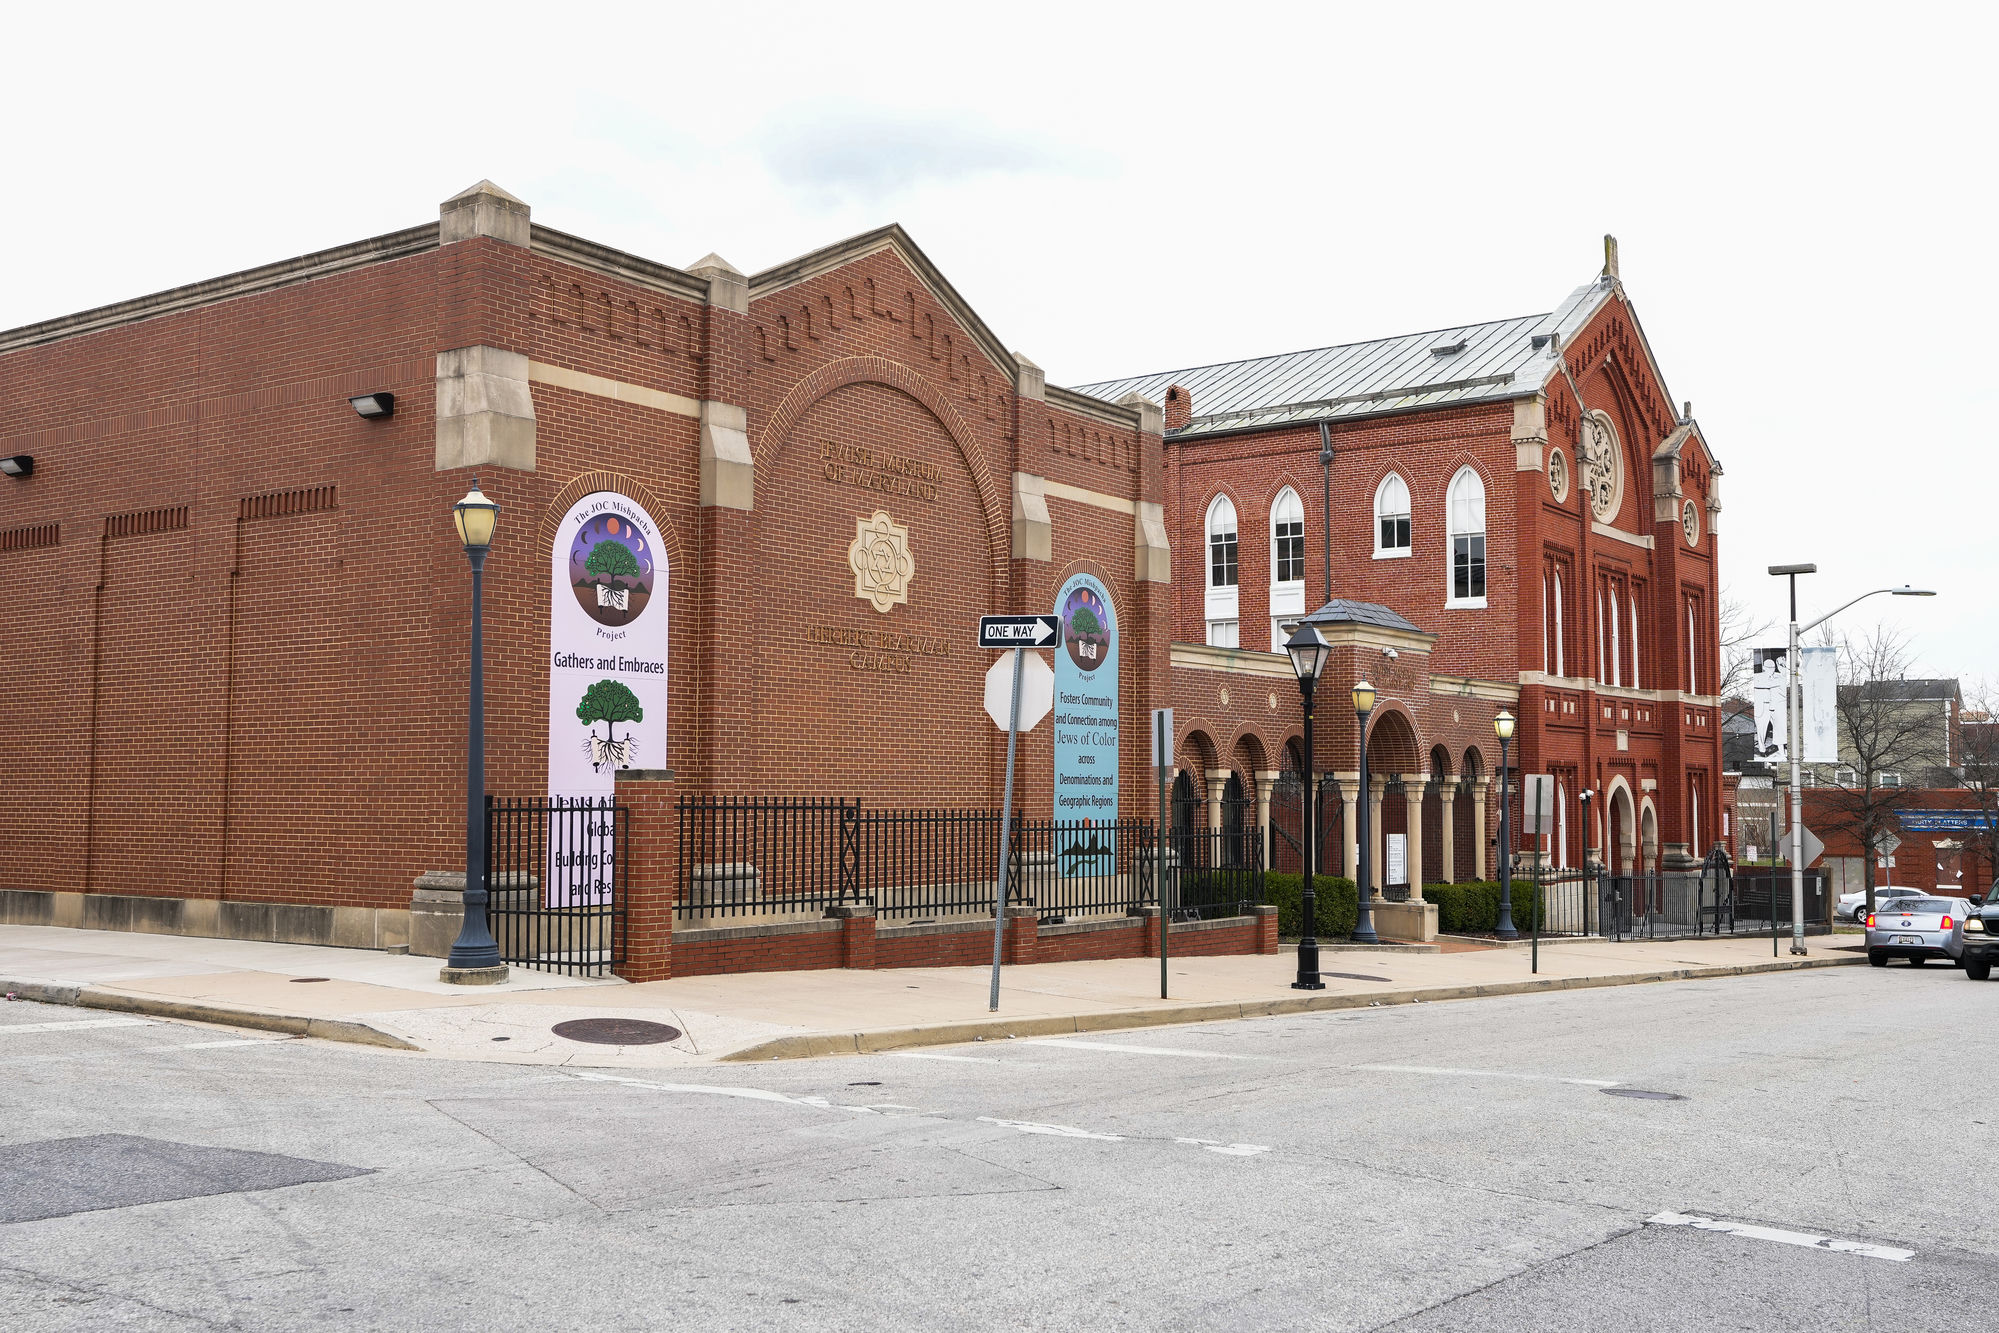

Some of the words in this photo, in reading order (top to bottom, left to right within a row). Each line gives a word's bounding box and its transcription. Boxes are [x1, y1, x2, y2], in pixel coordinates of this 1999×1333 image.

[819, 439, 874, 467] JEWISH
[881, 452, 942, 482] MUSEUM
[824, 463, 844, 481] OF
[852, 469, 938, 501] MARYLAND
[574, 509, 589, 525] The
[591, 501, 609, 514] JOC
[612, 501, 651, 536] Mishpacha
[1063, 585, 1072, 597] The
[1073, 578, 1083, 587] JOC
[596, 627, 627, 642] Project
[806, 624, 873, 648] HERBERT
[879, 632, 951, 657] BEARMAN
[988, 625, 1009, 638] ONE
[1013, 625, 1035, 638] WAY
[554, 651, 594, 670] Gathers
[597, 655, 616, 671] and
[619, 656, 664, 674] Embraces
[850, 650, 912, 674] CAMPUS
[1078, 671, 1096, 683] Project
[1060, 691, 1080, 705] Fosters
[1081, 693, 1113, 710] Community
[1055, 712, 1067, 724] and
[1067, 713, 1098, 726] Connection
[1098, 717, 1118, 730] among
[1057, 730, 1078, 745] Jews
[1080, 731, 1091, 745] of
[1092, 731, 1116, 747] Color
[1078, 755, 1095, 765] across
[1060, 772, 1102, 786] Denominations
[1102, 773, 1114, 786] and
[1058, 794, 1091, 810] Geographic
[1091, 794, 1114, 810] Regions
[555, 850, 598, 870] Buldng
